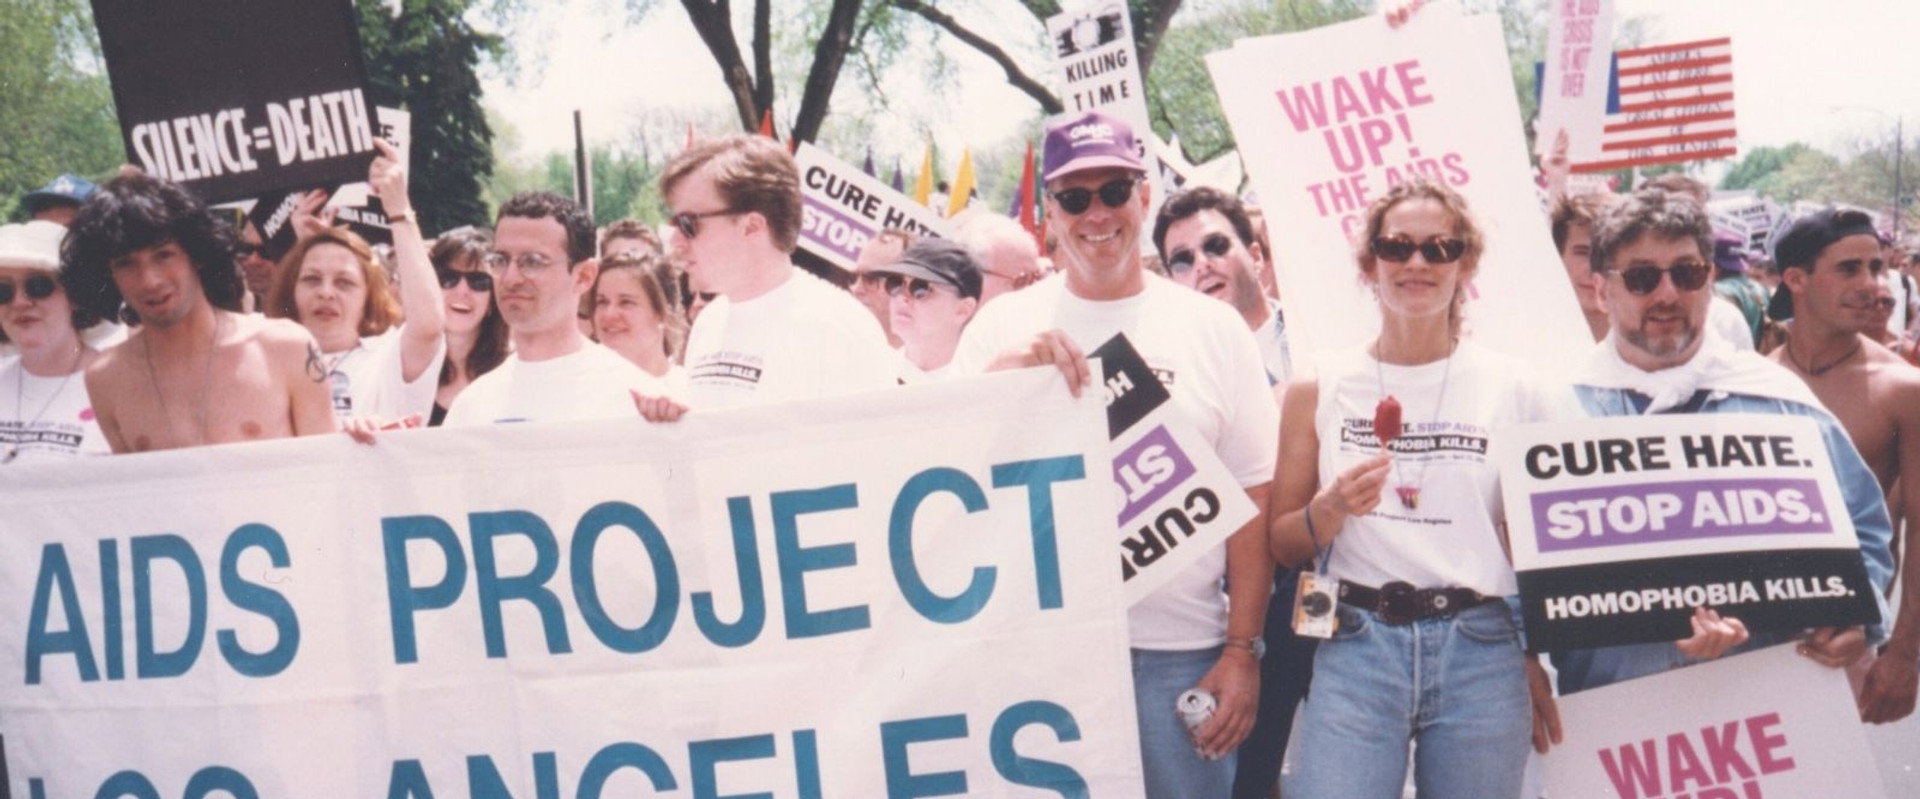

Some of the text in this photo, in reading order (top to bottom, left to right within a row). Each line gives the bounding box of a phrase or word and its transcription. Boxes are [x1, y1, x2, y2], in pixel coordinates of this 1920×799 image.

[1065, 49, 1128, 83] KILLING
[1073, 80, 1130, 111] TIME
[1275, 59, 1434, 133] WAKE
[131, 87, 374, 184] SILENCE=DEATH
[1323, 112, 1421, 174] UP!
[805, 165, 883, 222] CURE
[1305, 151, 1470, 218] THE ADS
[801, 203, 869, 254] STOP
[1343, 431, 1437, 451] HOMHOBIA
[1439, 437, 1484, 451] KILLS.
[1525, 434, 1813, 480] CURE HATE.
[1547, 487, 1824, 539] STOP AIDS.
[24, 453, 1087, 686] AIDS PROJECT
[1545, 575, 1856, 620] HOMOPHOBIA KILLS.
[1597, 711, 1797, 799] WAKE
